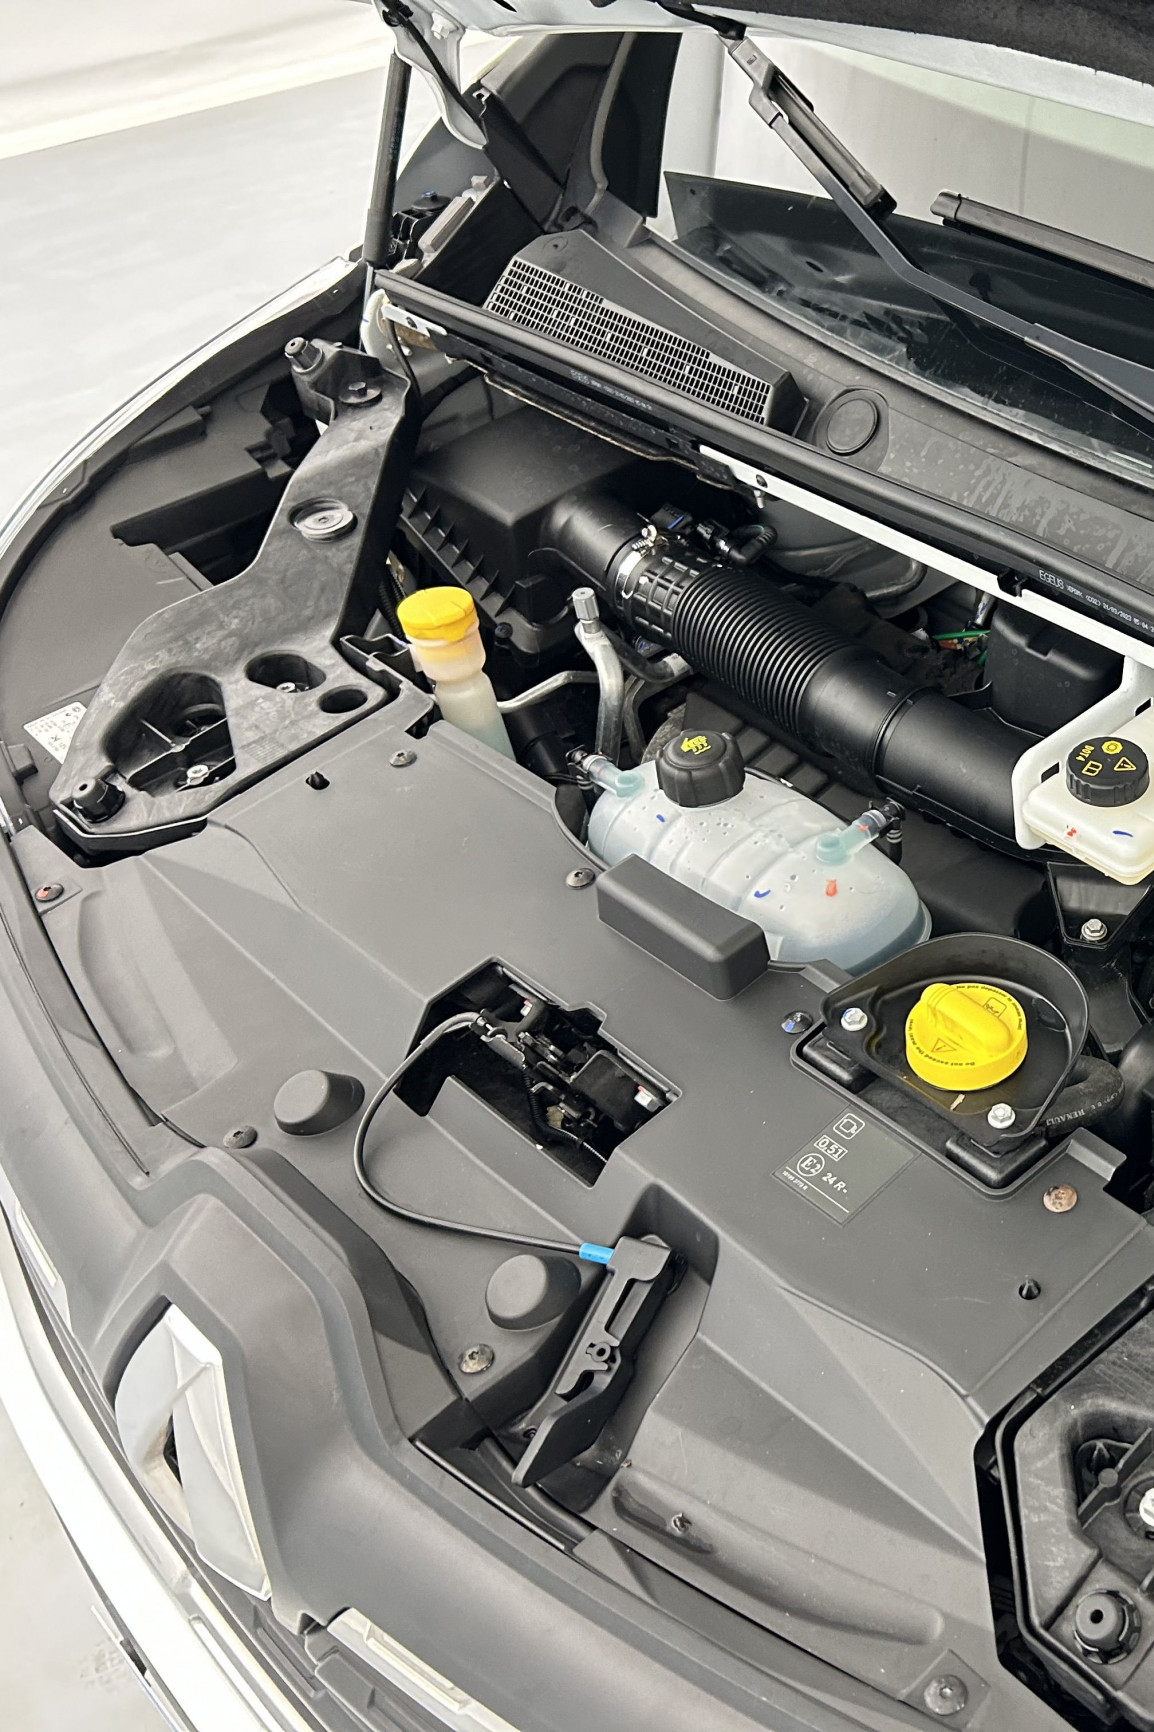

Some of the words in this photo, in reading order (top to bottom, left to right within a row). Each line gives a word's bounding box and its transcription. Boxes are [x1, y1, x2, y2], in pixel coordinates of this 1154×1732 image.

[1039, 569, 1065, 590] EGEUS
[800, 1156, 821, 1174] E2
[821, 1172, 838, 1185] 24
